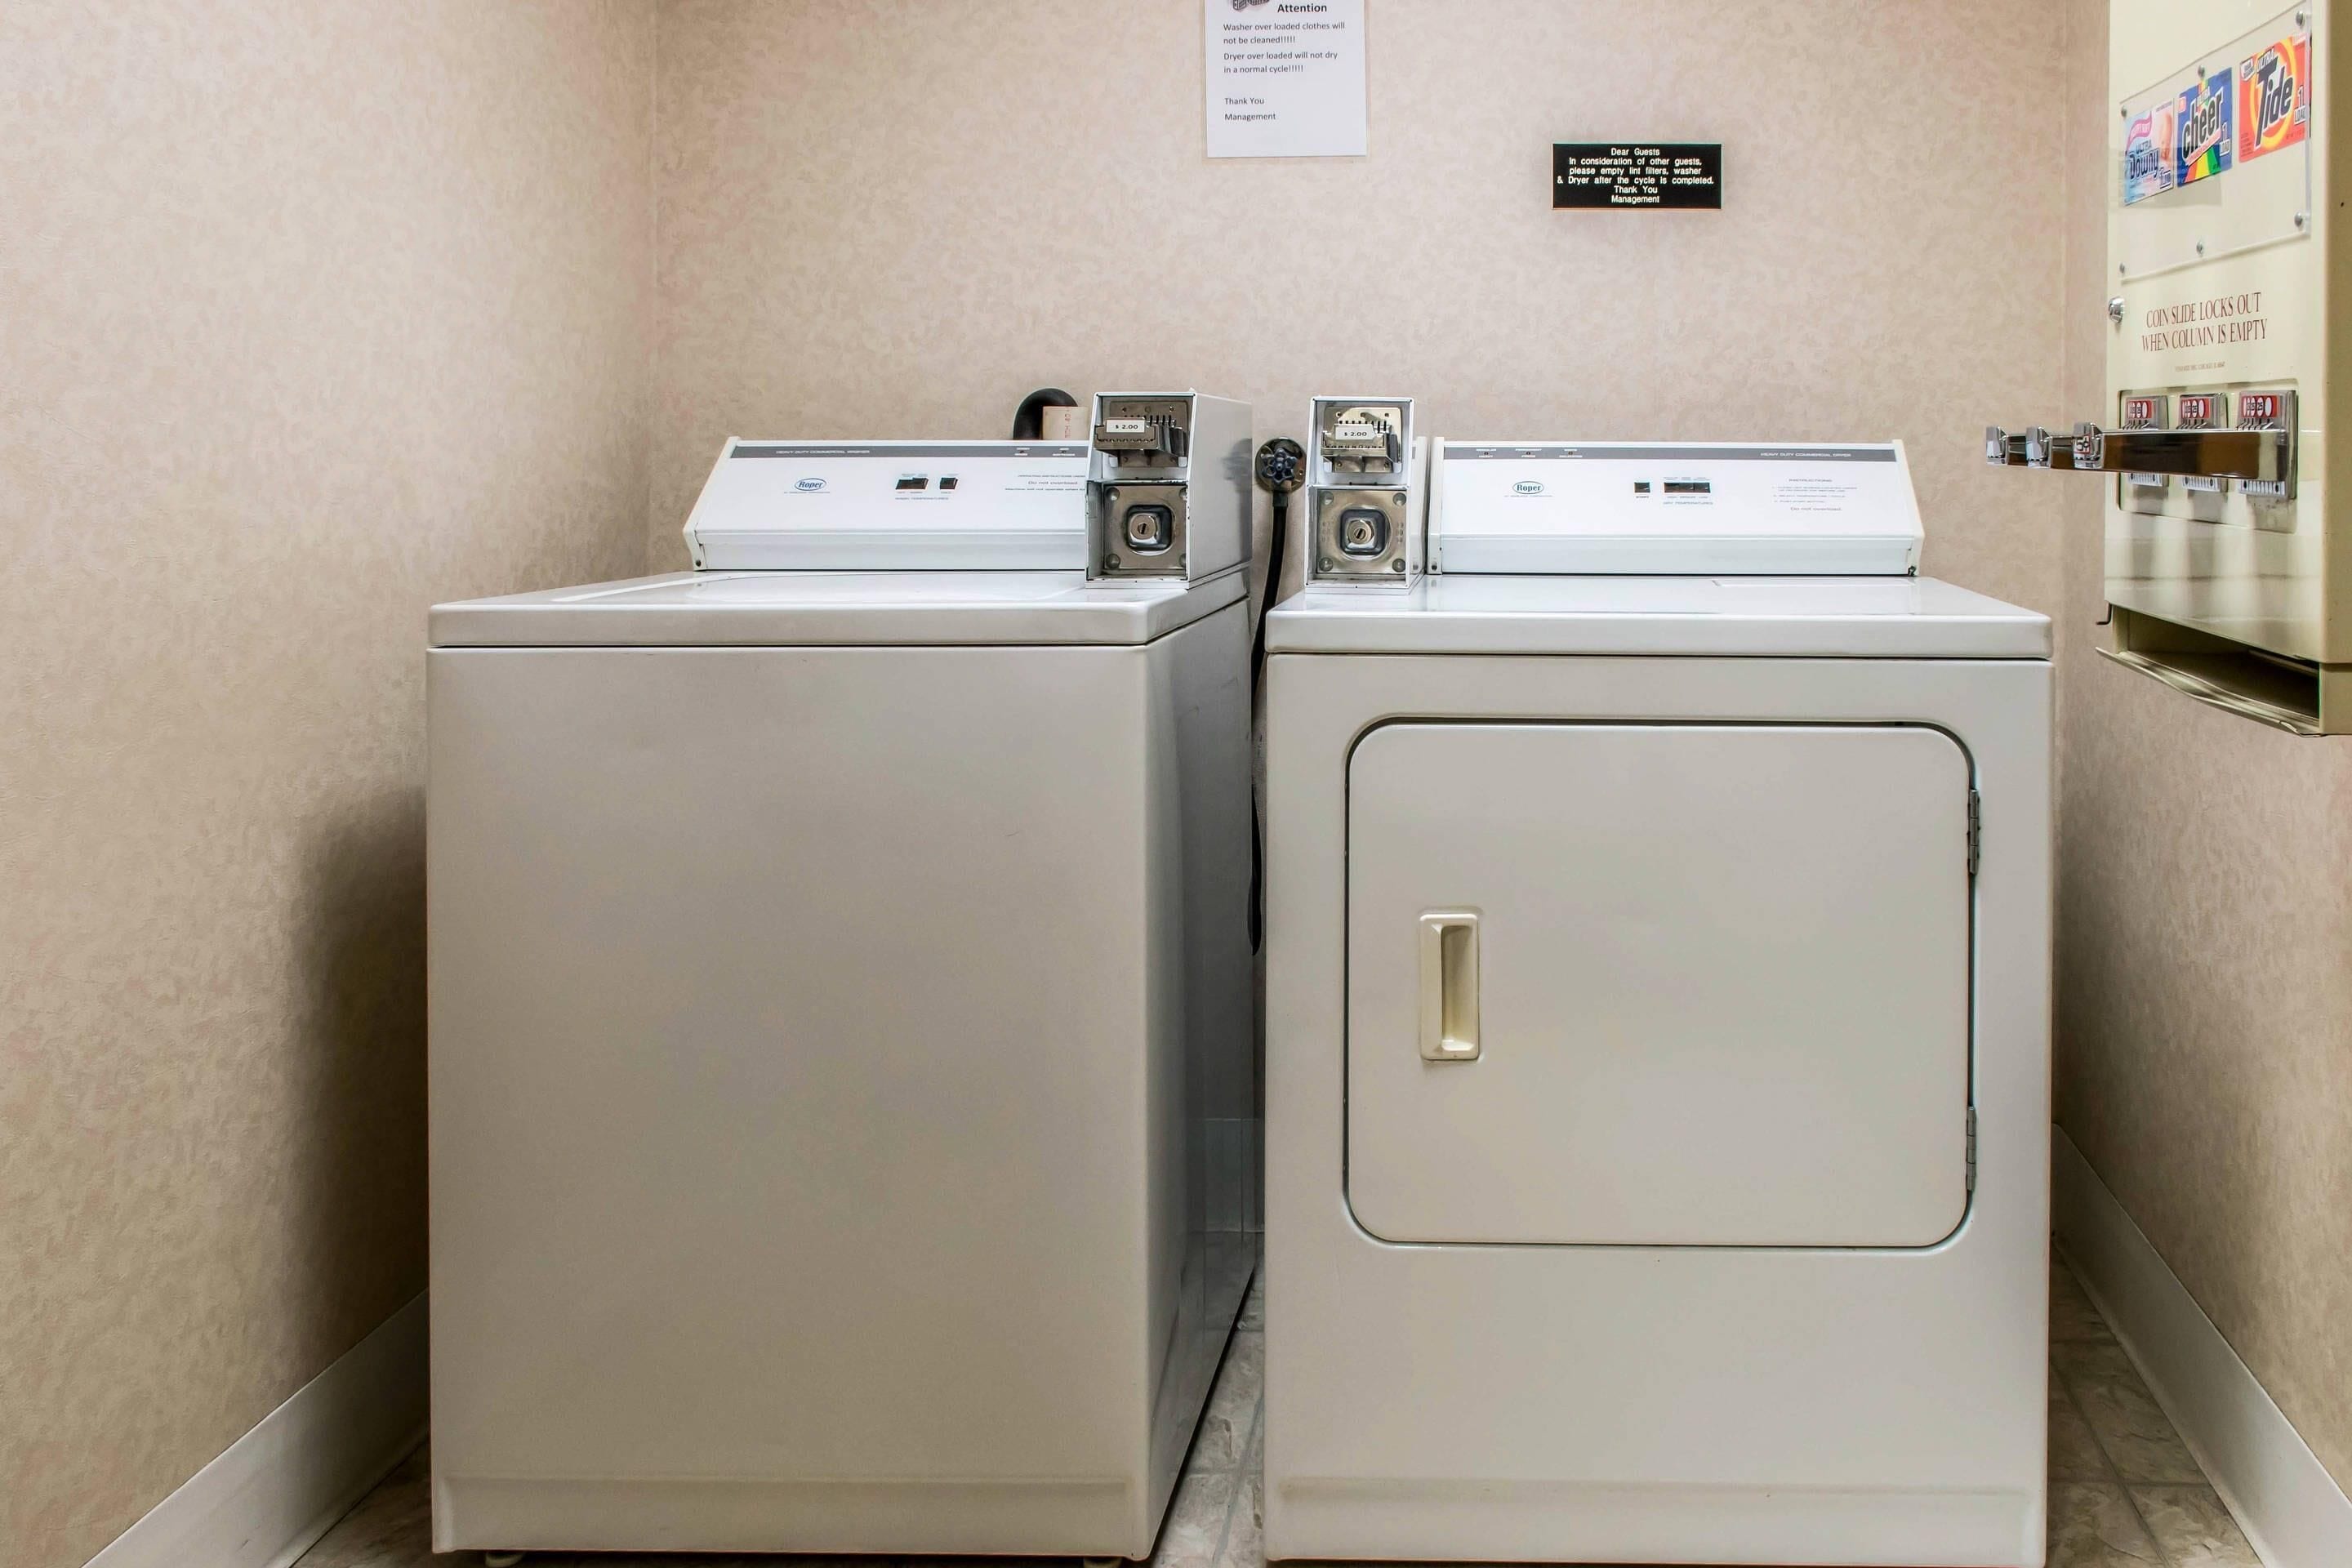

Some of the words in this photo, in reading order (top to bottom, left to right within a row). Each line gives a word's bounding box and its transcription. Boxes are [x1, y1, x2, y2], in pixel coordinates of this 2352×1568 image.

[1277, 3, 1327, 13] Attention
[1274, 22, 1300, 30] loaded
[1302, 22, 1330, 30] clothes
[1223, 53, 1245, 61] Dryer
[1325, 51, 1338, 60] dry
[2254, 55, 2293, 149] Tide
[1224, 113, 1276, 122] Management
[2183, 88, 2222, 159] cheer
[2136, 140, 2152, 154] ULTRA
[1569, 157, 1576, 165] In
[1580, 157, 1633, 165] consideration
[1674, 158, 1702, 167] guests,
[2129, 148, 2159, 180] Downy
[1569, 167, 1596, 175] please
[1600, 167, 1624, 176] empty
[1628, 167, 1641, 175] lint
[1645, 167, 1669, 176] filters,
[1568, 176, 1589, 185] Dryer
[1633, 176, 1655, 185] cycle
[1672, 176, 1714, 185] completed.
[1614, 185, 1637, 194] Thank
[1642, 185, 1658, 194] You
[1611, 195, 1660, 204] Management
[2146, 307, 2169, 328] COIN
[2171, 303, 2196, 325] SLIDE
[2199, 296, 2234, 321] LOCKS
[2237, 292, 2261, 315] OUT
[2141, 330, 2169, 353] WHEN
[2172, 325, 2214, 350] COLUMN
[2217, 324, 2226, 344] IS
[2230, 318, 2268, 343] EMPTY
